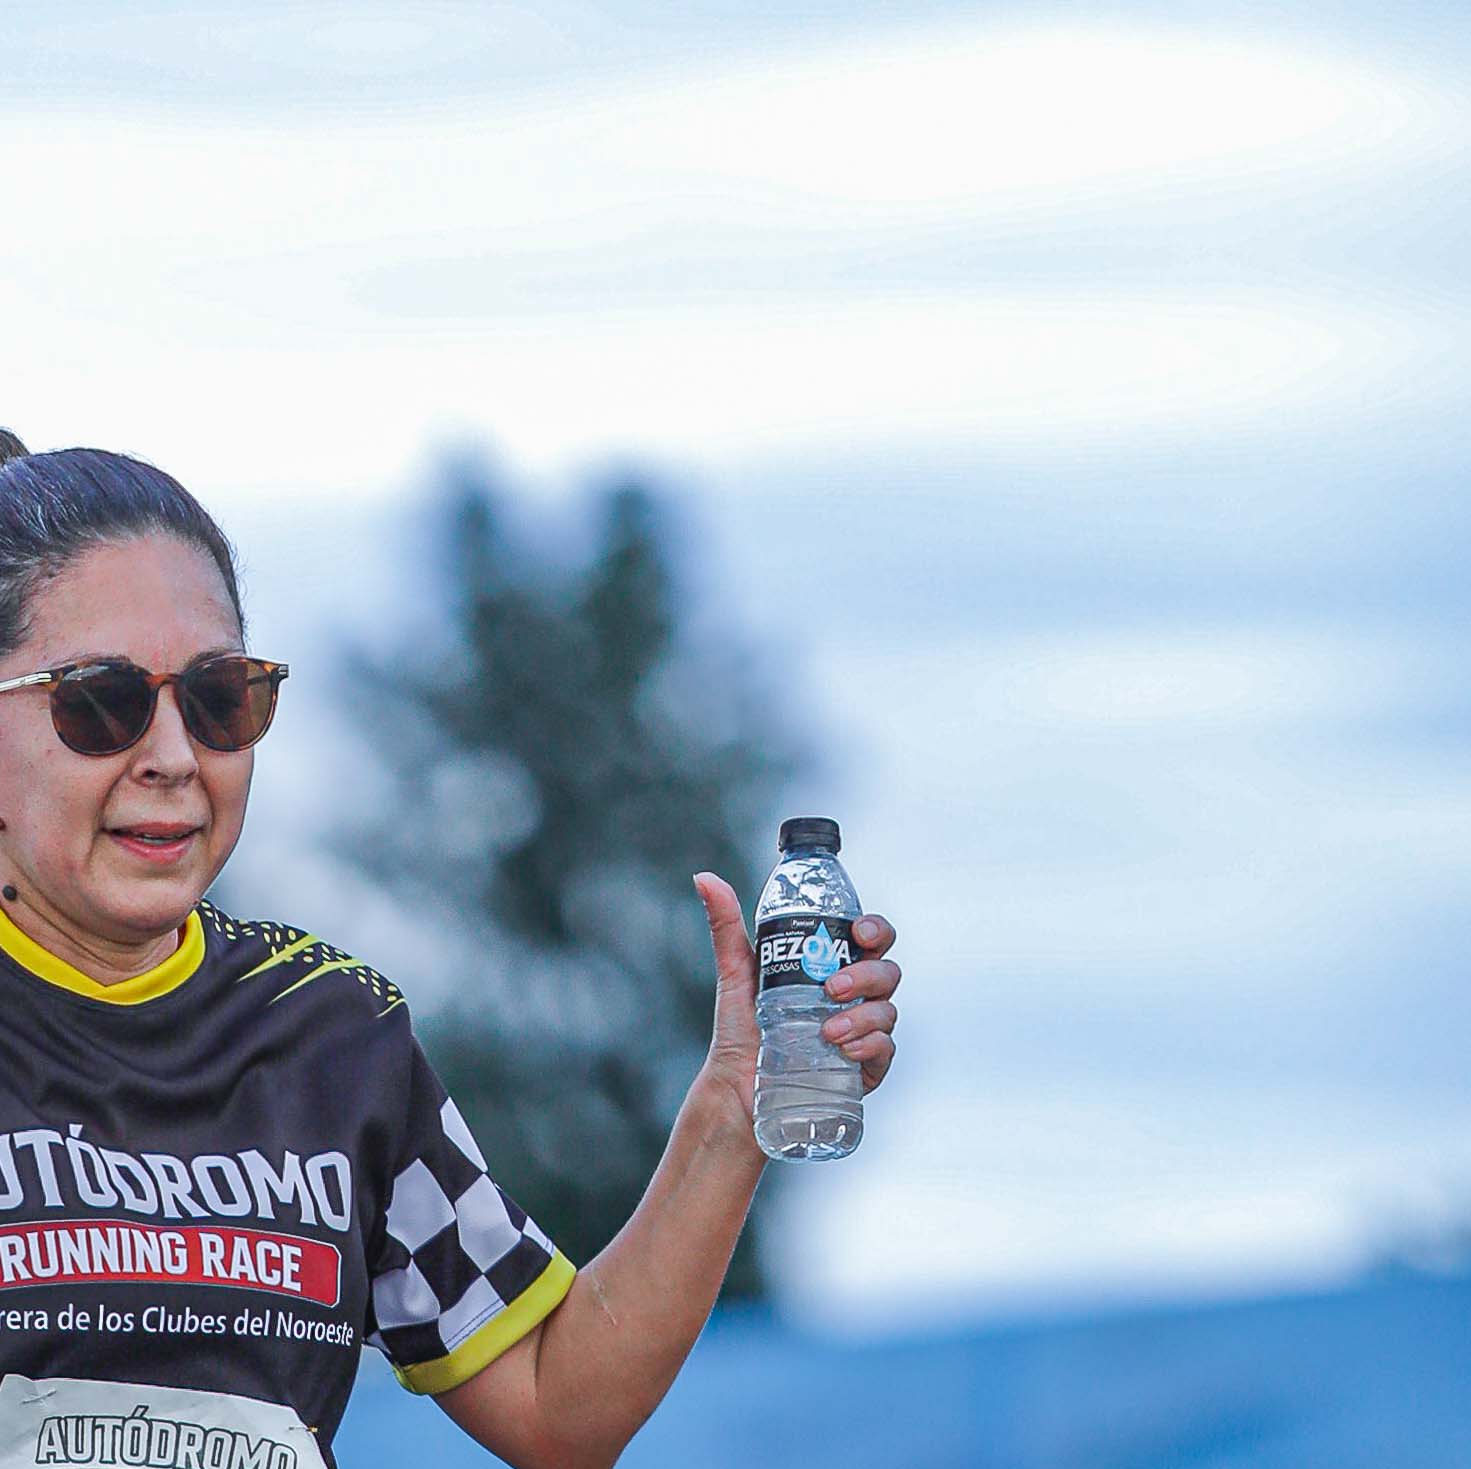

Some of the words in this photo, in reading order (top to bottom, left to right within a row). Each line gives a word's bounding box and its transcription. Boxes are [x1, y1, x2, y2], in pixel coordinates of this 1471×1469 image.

[760, 934, 852, 968] BEZOYA
[199, 1232, 304, 1292] RACE
[57, 1303, 90, 1331] de
[98, 1304, 135, 1333] los
[142, 1306, 227, 1334] Clubes
[233, 1308, 270, 1337] del
[276, 1311, 355, 1347] Noroeste
